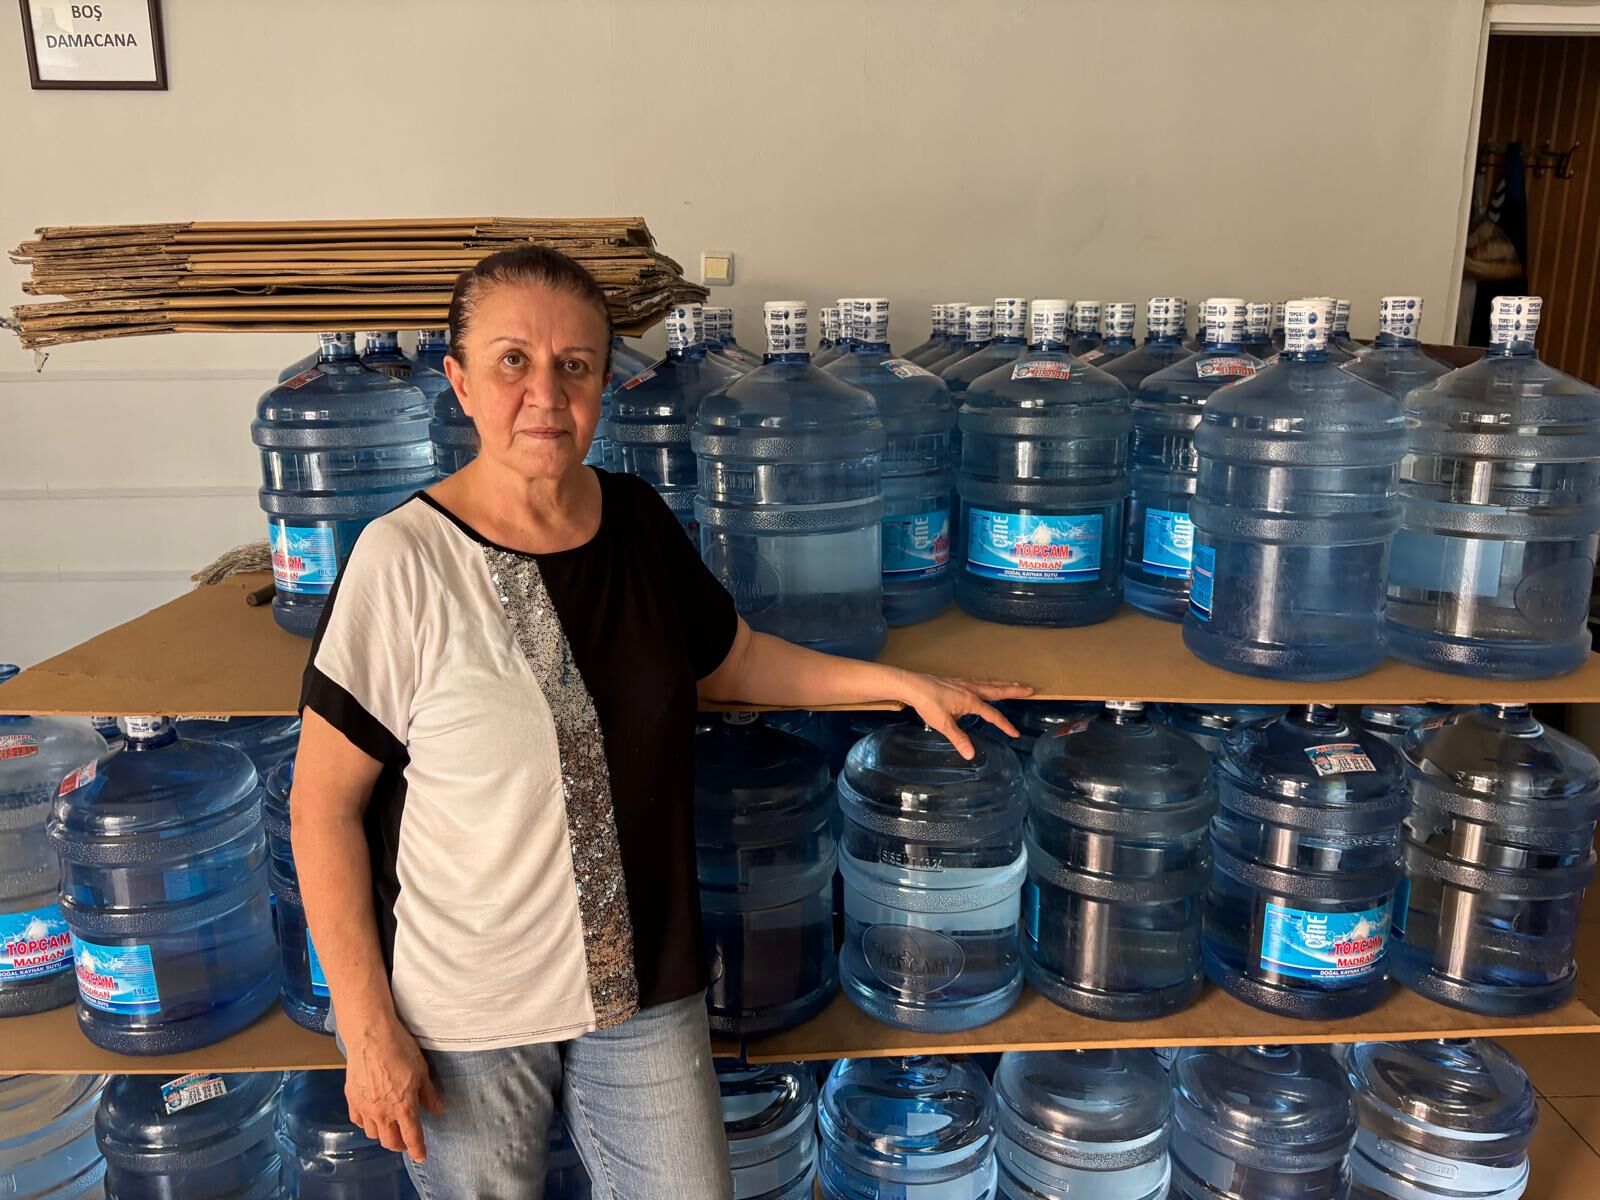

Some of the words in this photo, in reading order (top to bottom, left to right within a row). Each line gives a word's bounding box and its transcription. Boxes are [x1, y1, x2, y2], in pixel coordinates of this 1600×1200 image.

[71, 5, 103, 21] BOŞ
[46, 33, 138, 48] DAMACANA
[1015, 543, 1070, 560] TOPÇAM
[1018, 559, 1063, 570] MADRAN
[6, 932, 71, 956] TOPÇAM
[1334, 934, 1383, 956] TOPÇAM
[13, 949, 65, 968] MADRAN
[1337, 951, 1375, 967] MADRAN
